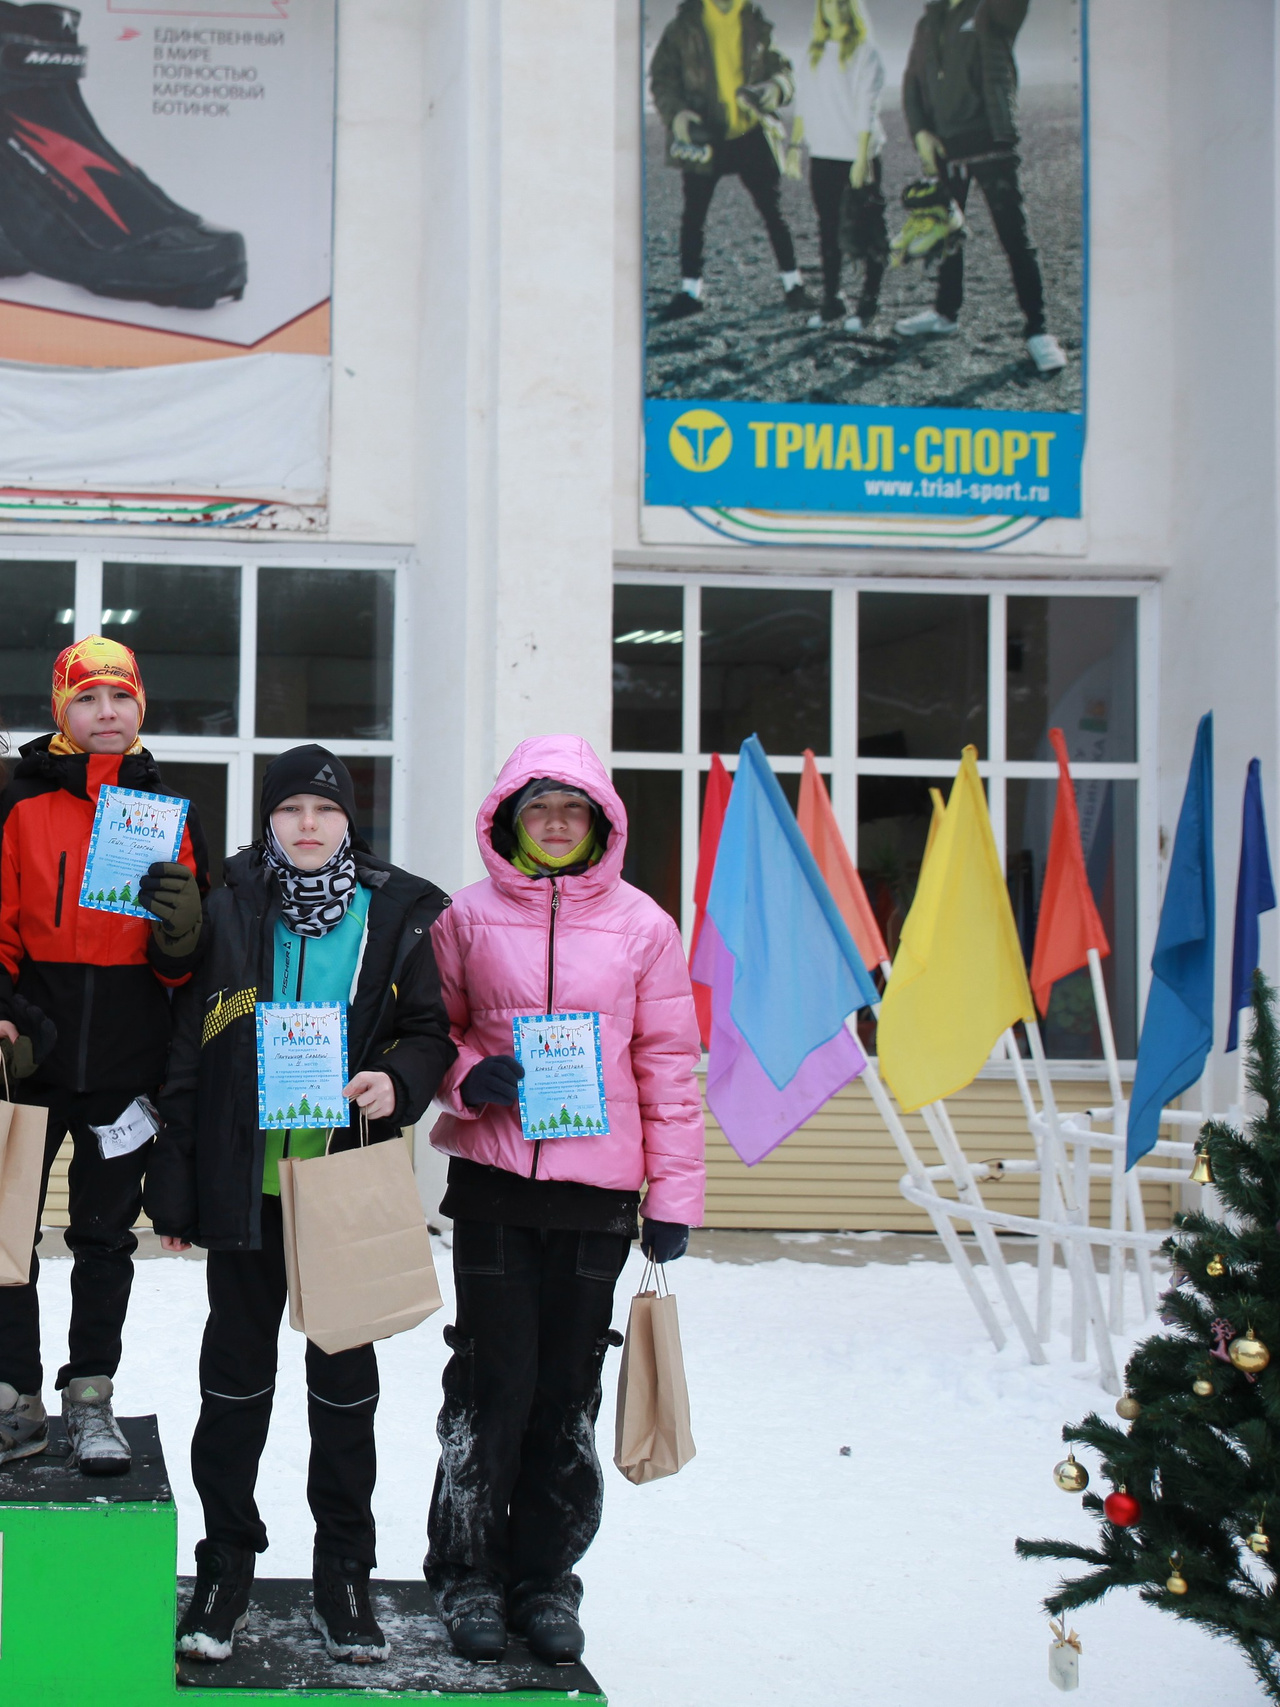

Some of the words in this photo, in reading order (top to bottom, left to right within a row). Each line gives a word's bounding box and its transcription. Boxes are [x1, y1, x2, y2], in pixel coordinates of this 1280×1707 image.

[154, 27, 285, 46] ЕДИНСТВЕННЫЙ
[153, 46, 163, 61] В
[166, 47, 210, 62] МИРЕ
[153, 64, 258, 82] ПОЛНОСТЬЮ
[153, 82, 265, 100] КАРБОНОВЫЙ
[153, 100, 230, 117] БОТИНОК
[865, 478, 1050, 503] www.trial-sport.ru
[79, 669, 129, 679] FISCHER
[110, 821, 165, 839] ГРАМОТА
[282, 951, 291, 996] FISCHER
[273, 1036, 330, 1046] ГРАМОТА
[530, 1047, 585, 1058] ГРАМОТА
